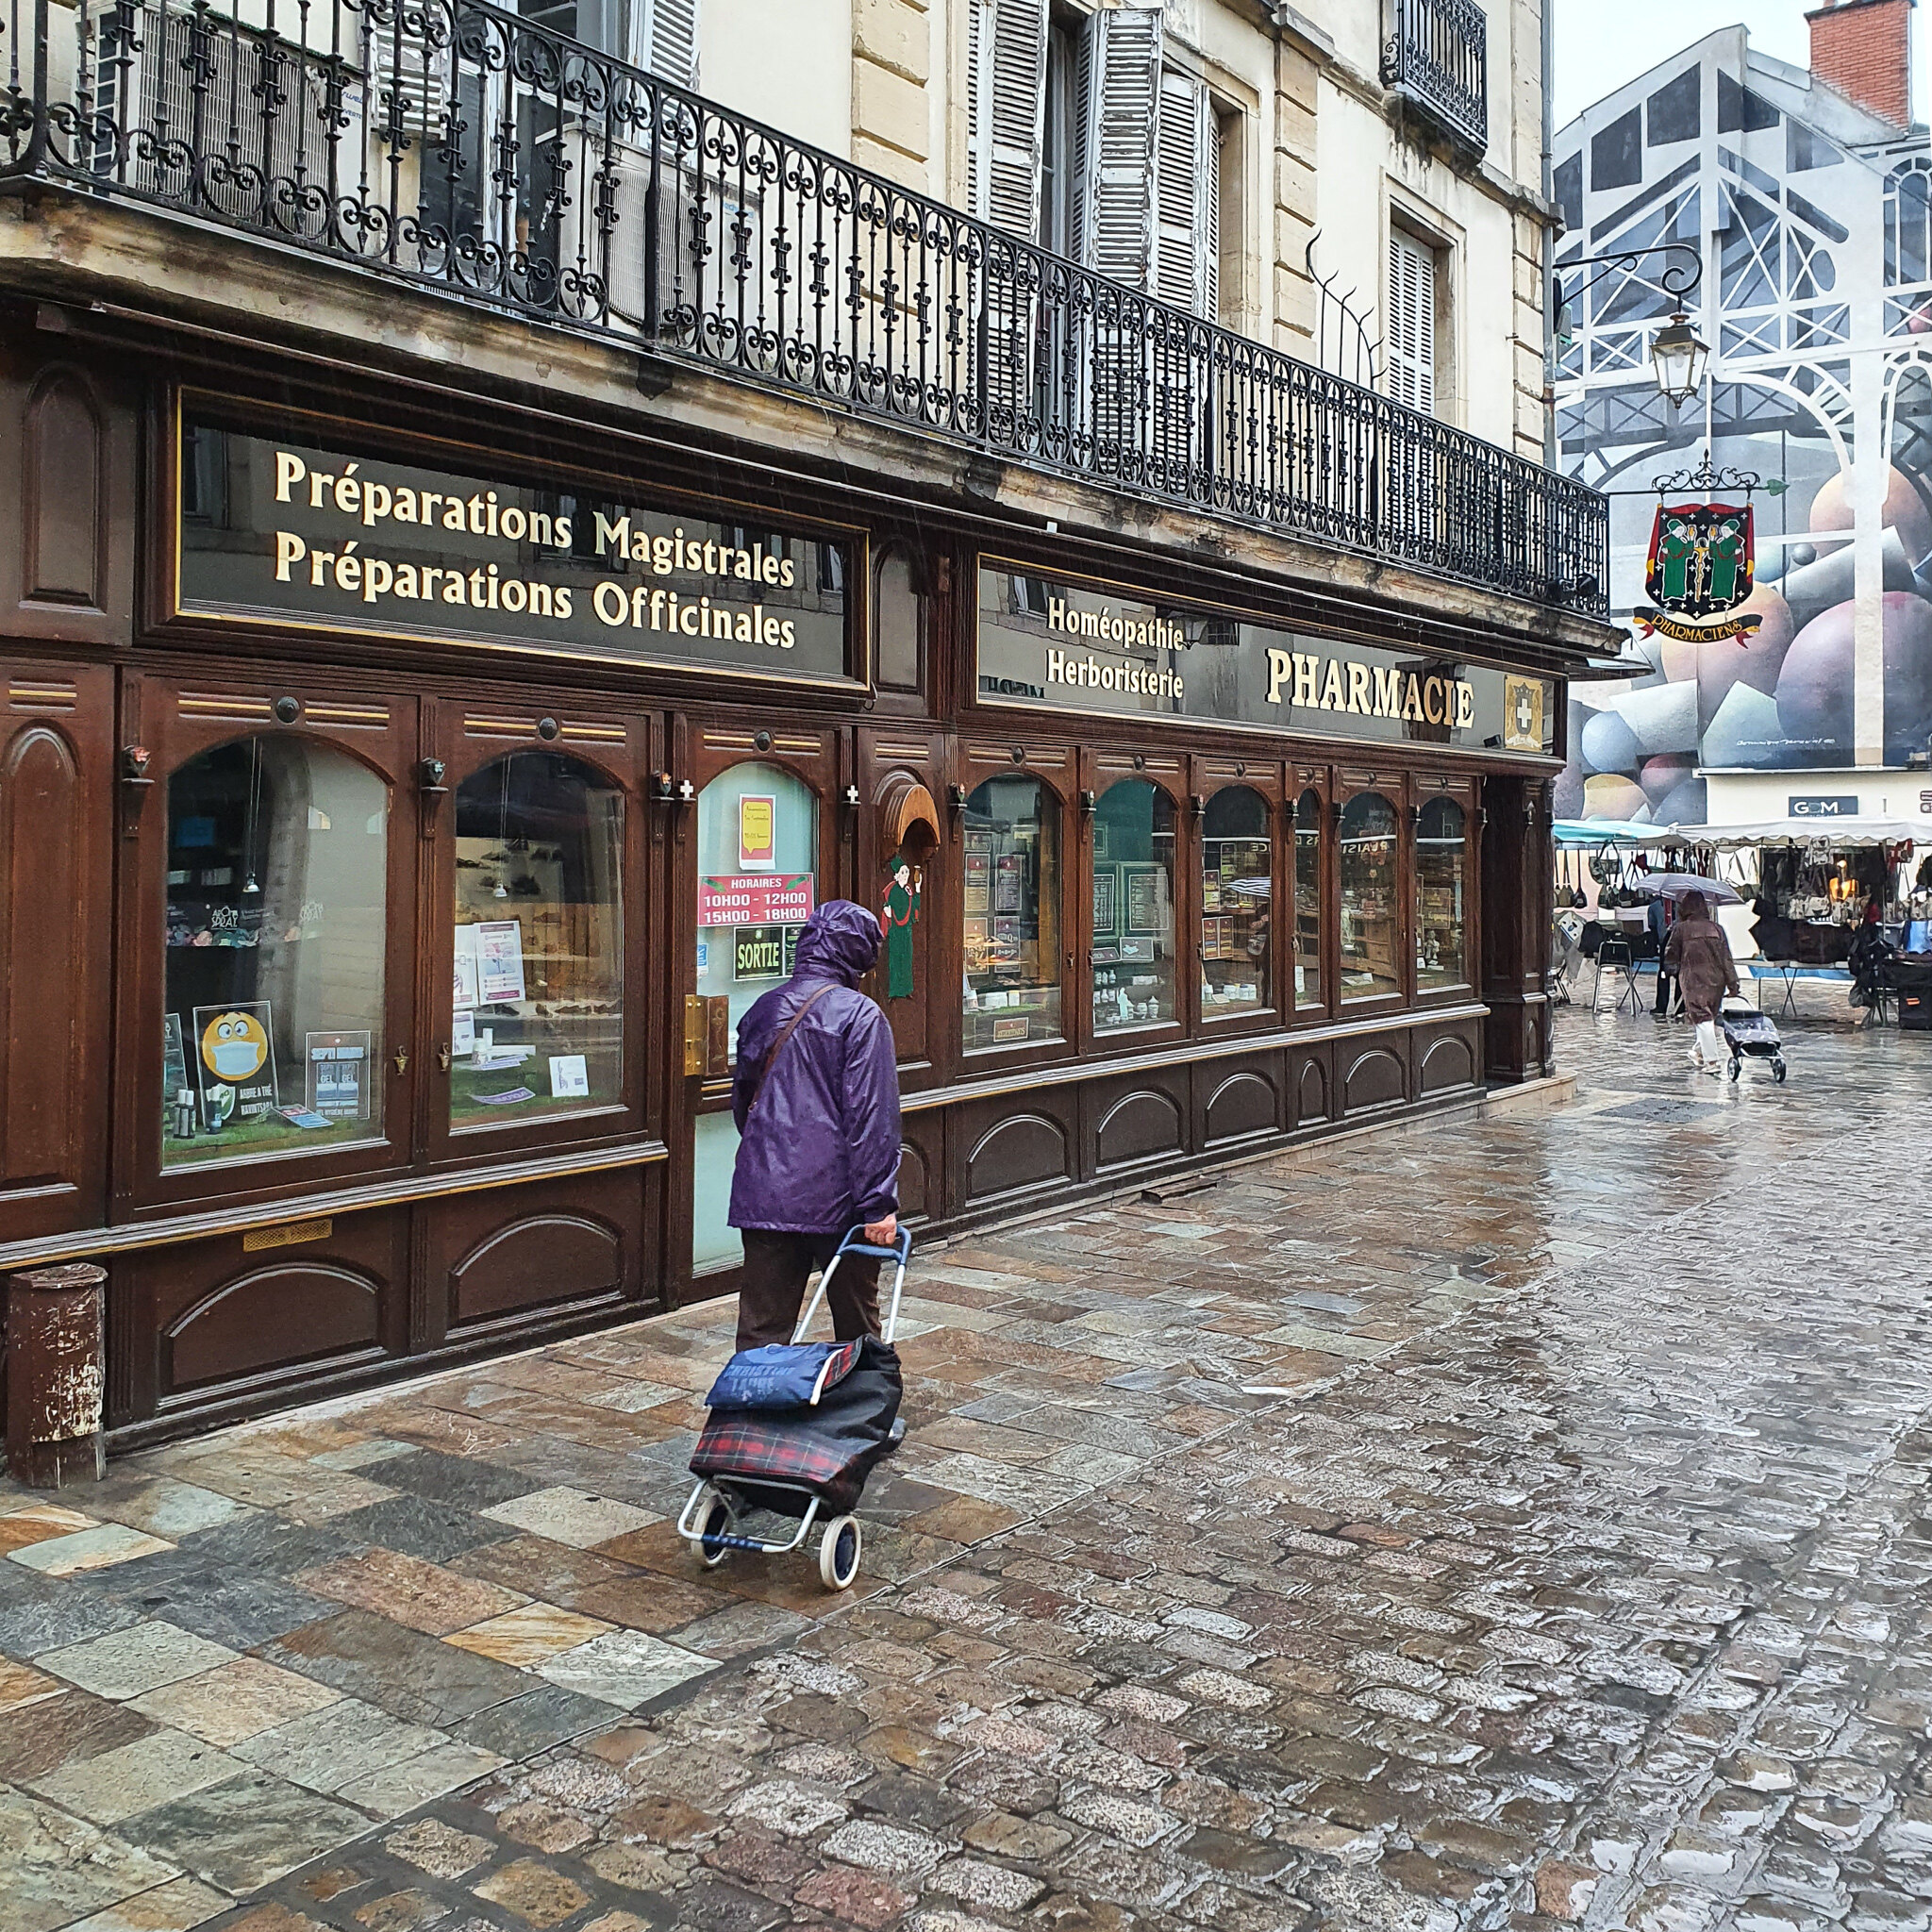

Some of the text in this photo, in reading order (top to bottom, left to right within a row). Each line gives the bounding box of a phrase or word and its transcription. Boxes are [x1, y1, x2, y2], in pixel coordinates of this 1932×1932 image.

[275, 452, 795, 588] Préparations Magistrales
[275, 531, 795, 649] Préparations Officinales
[1047, 596, 1184, 653] Homéopathie
[1651, 614, 1742, 641] PHARMACIENS
[1047, 649, 1184, 699] Herboristerie
[1265, 648, 1474, 728] PHARMACIE
[704, 894, 750, 907] 10H00
[764, 892, 807, 905] 12H00
[731, 878, 782, 889] HORAIRES
[704, 910, 750, 924] 15H00
[764, 908, 807, 920] 18H00
[738, 942, 779, 969] SORTIE
